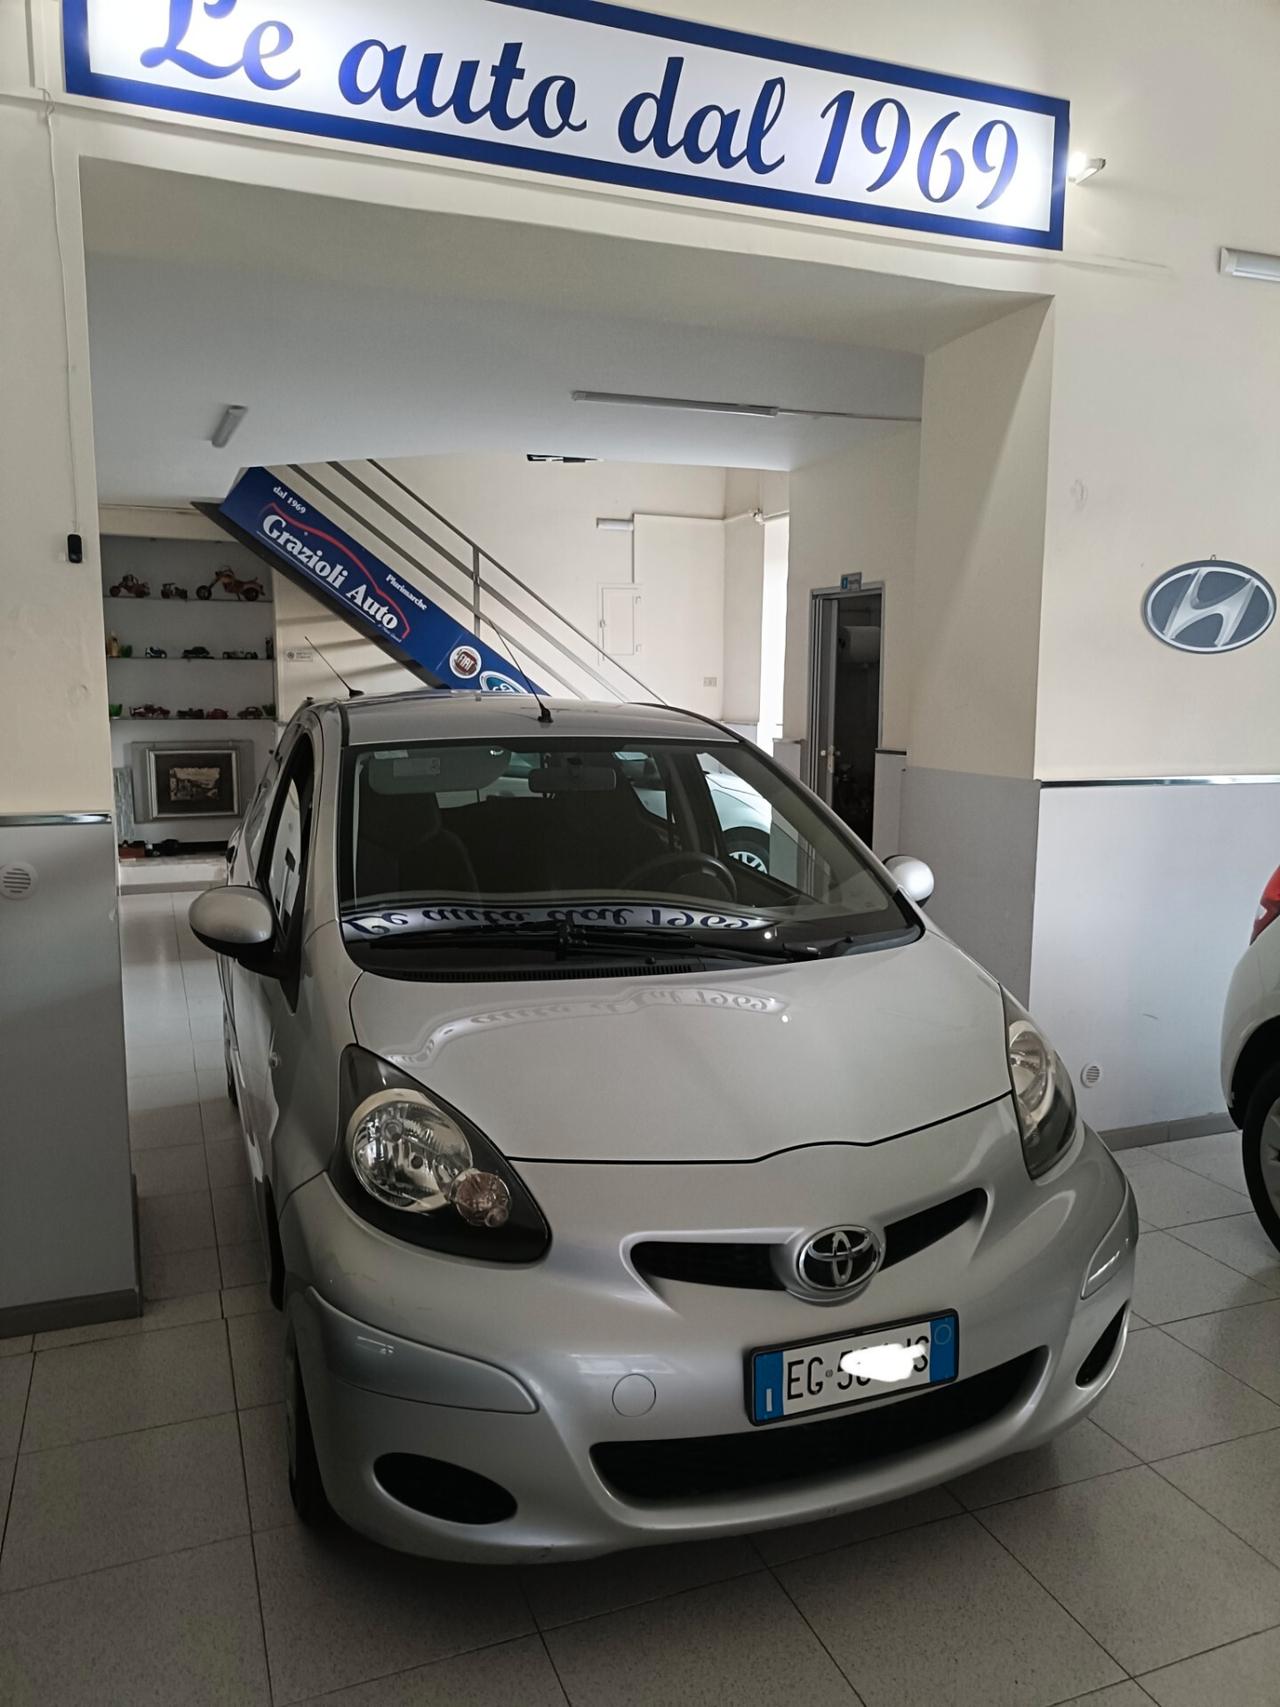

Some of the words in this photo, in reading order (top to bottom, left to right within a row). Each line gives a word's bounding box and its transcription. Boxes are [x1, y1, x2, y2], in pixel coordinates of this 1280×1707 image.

[140, 0, 300, 90] Le
[338, 38, 587, 138] auto
[617, 56, 786, 175] dal
[814, 90, 1019, 210] 1969
[272, 486, 288, 500] dal
[287, 495, 307, 514] 1969
[262, 514, 348, 589] Grazioli
[346, 584, 398, 631] Auto
[385, 573, 427, 611] Plurimarche
[457, 654, 475, 671] FIAT
